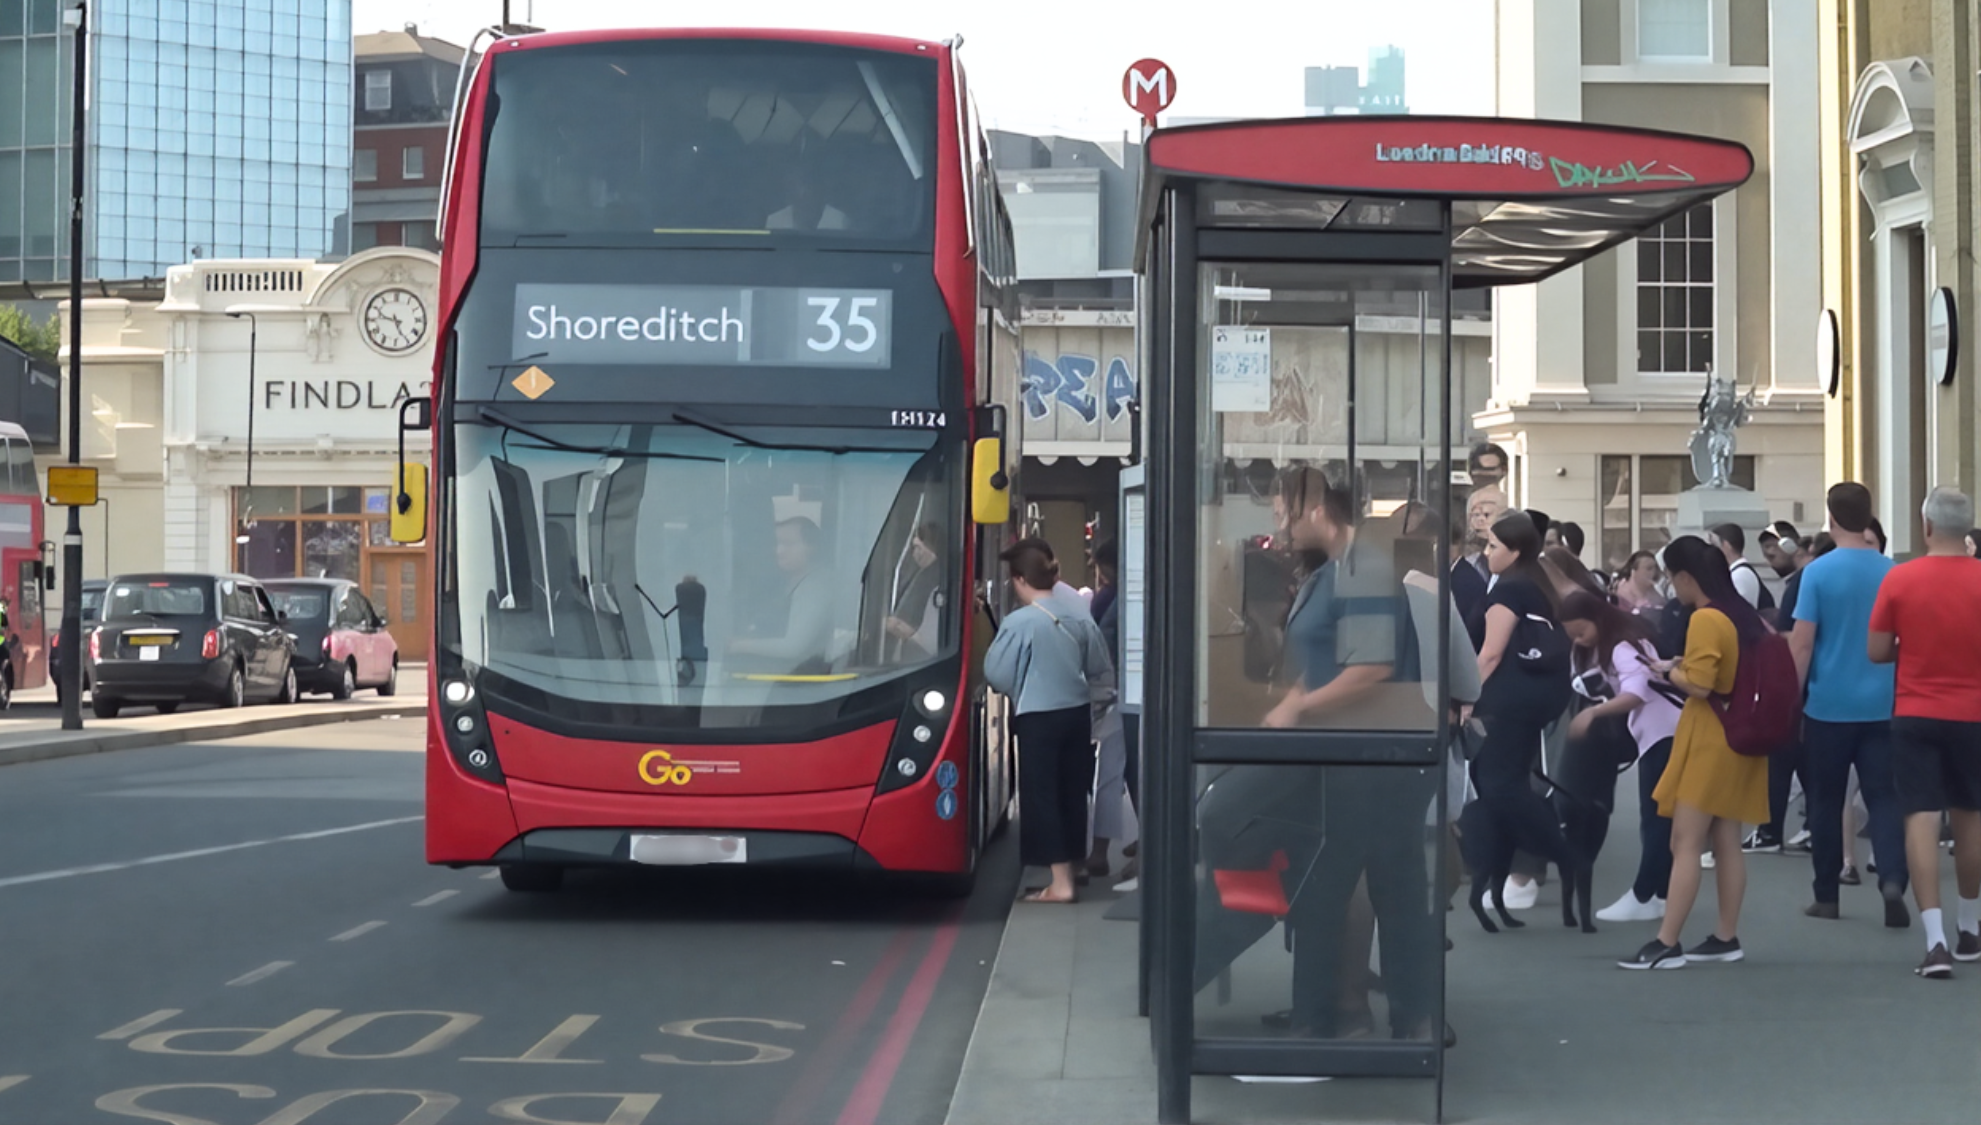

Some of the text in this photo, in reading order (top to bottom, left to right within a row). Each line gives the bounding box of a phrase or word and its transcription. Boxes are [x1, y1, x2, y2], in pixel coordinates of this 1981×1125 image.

[1130, 67, 1167, 106] M
[526, 297, 877, 352] Shoreditch 35
[265, 380, 433, 409] FINDLA
[638, 749, 692, 786] Go
[128, 1008, 805, 1065] STOP
